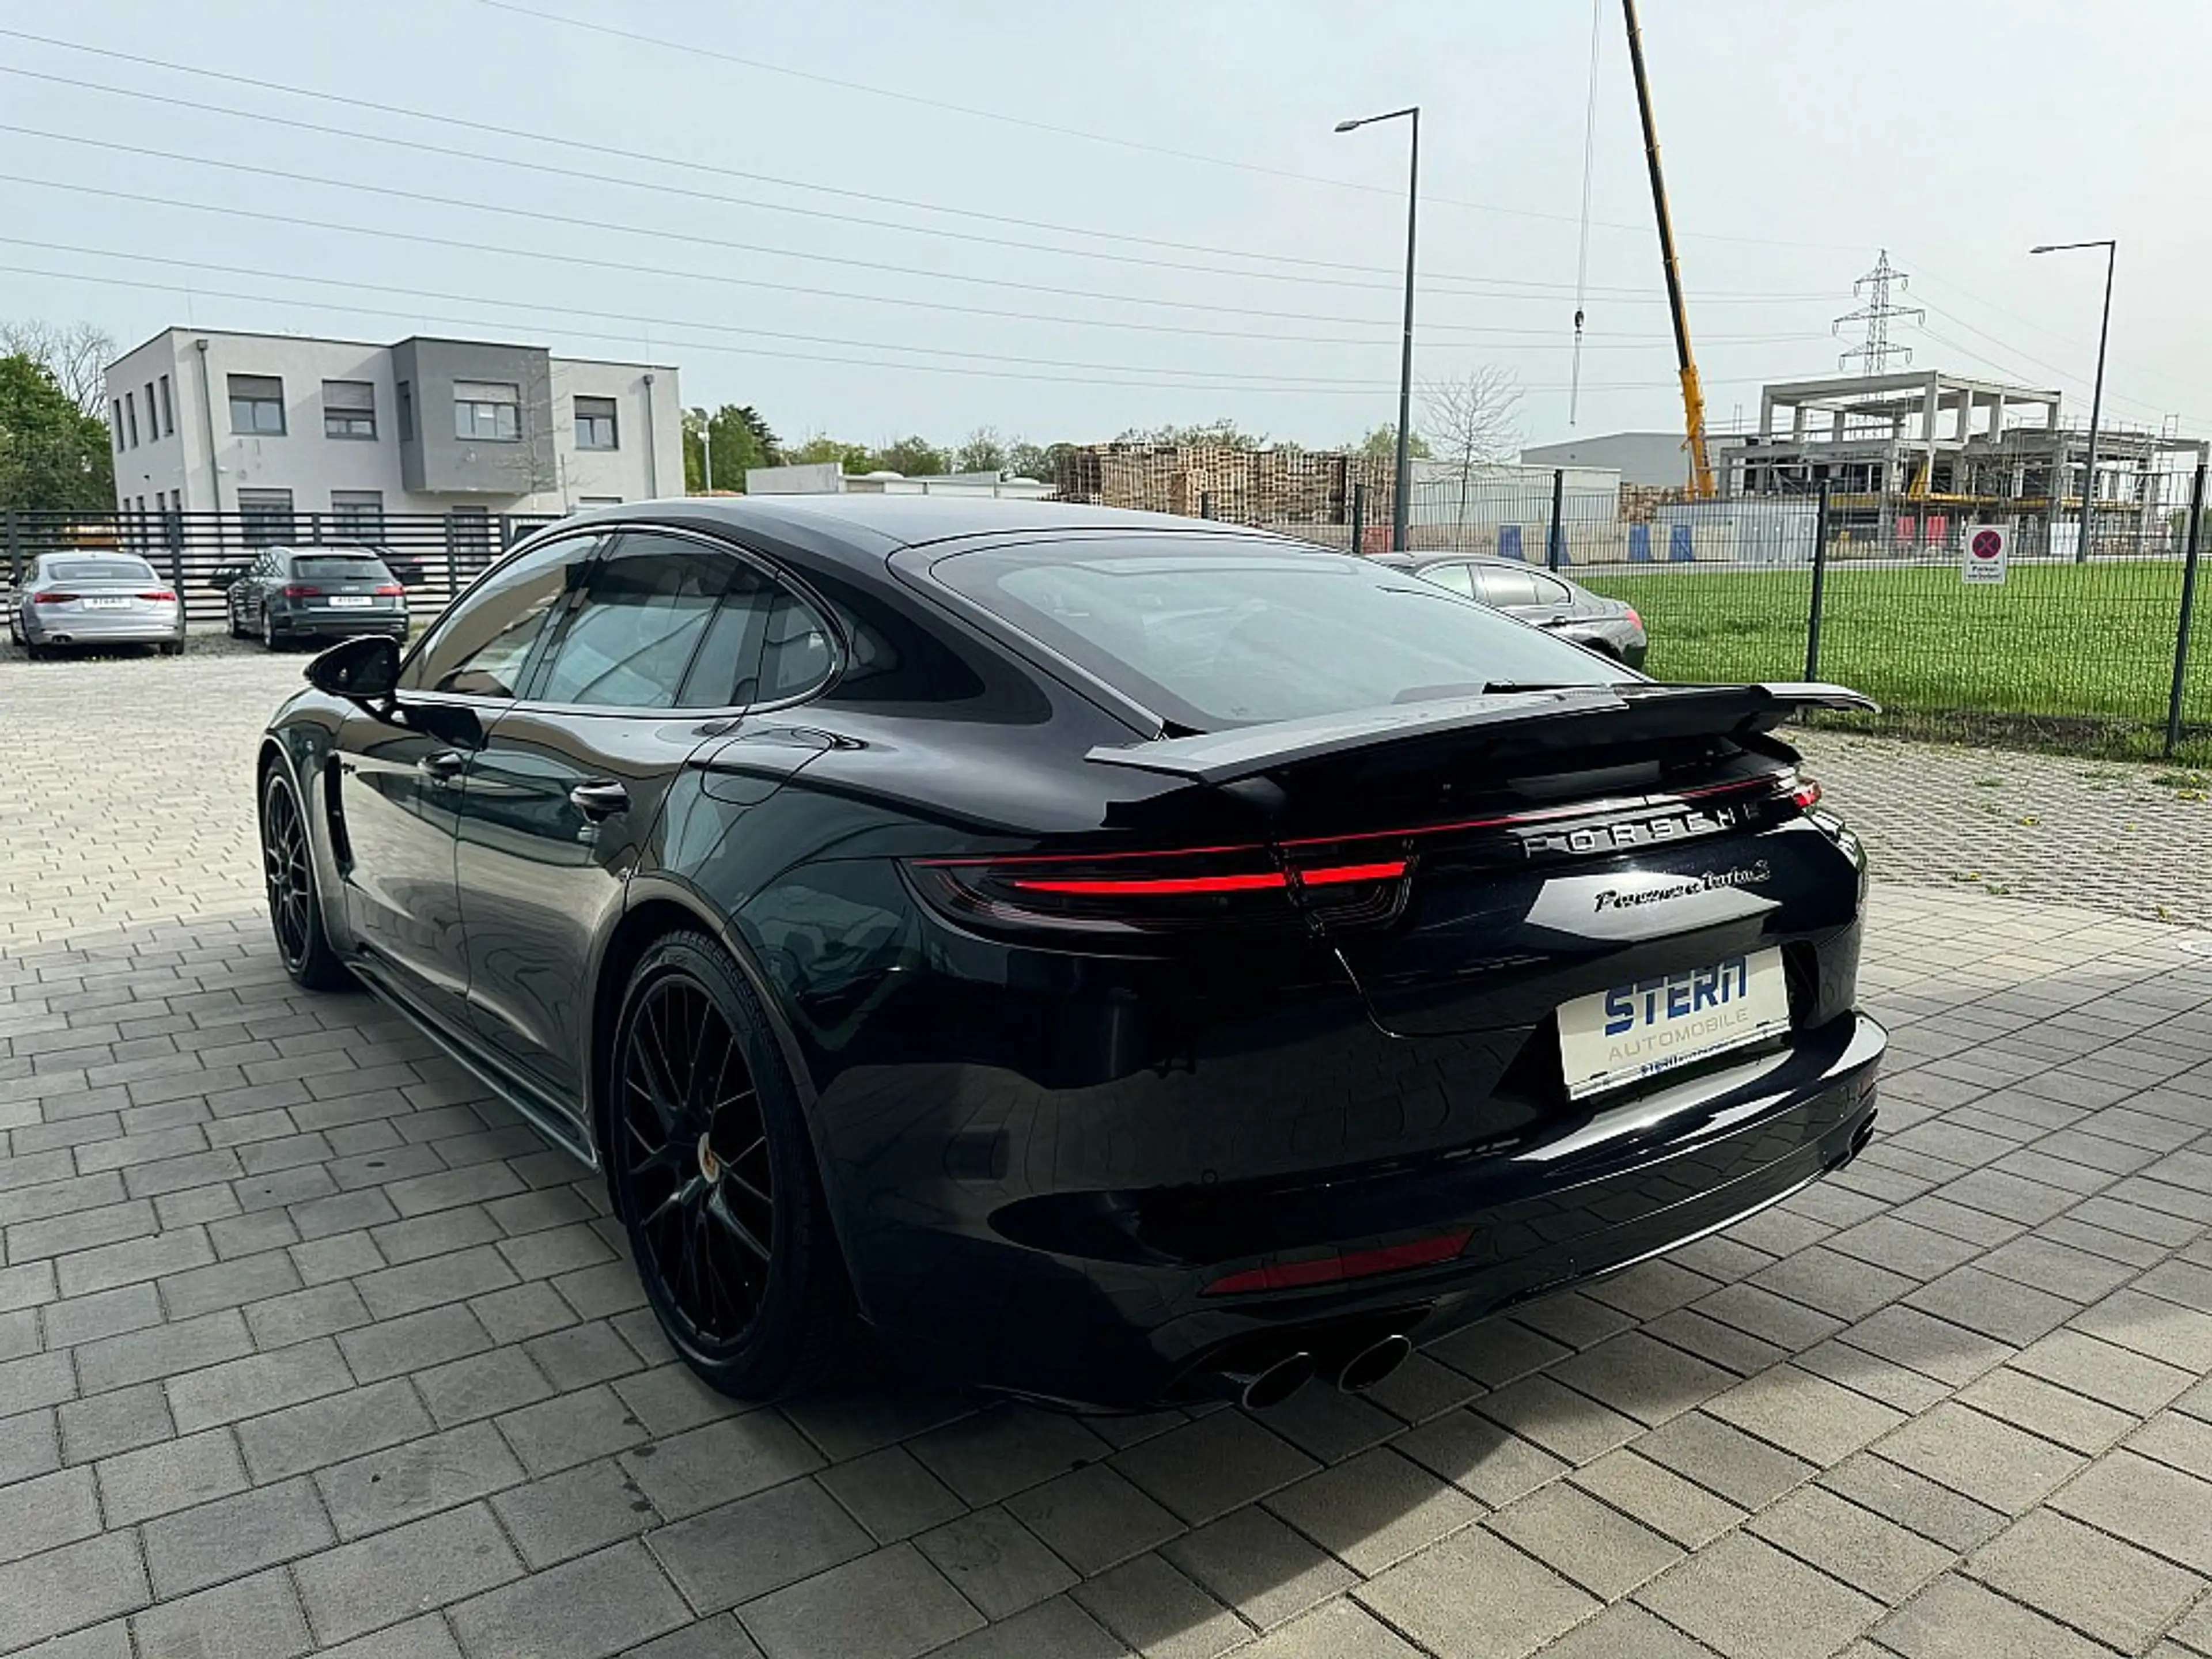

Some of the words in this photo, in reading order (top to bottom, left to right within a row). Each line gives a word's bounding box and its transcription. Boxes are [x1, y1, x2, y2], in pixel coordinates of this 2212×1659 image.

[1523, 803, 1760, 859] PORSCHE
[1604, 955, 1748, 1037] STERN
[1607, 1007, 1749, 1062] AUTOMOBILE
